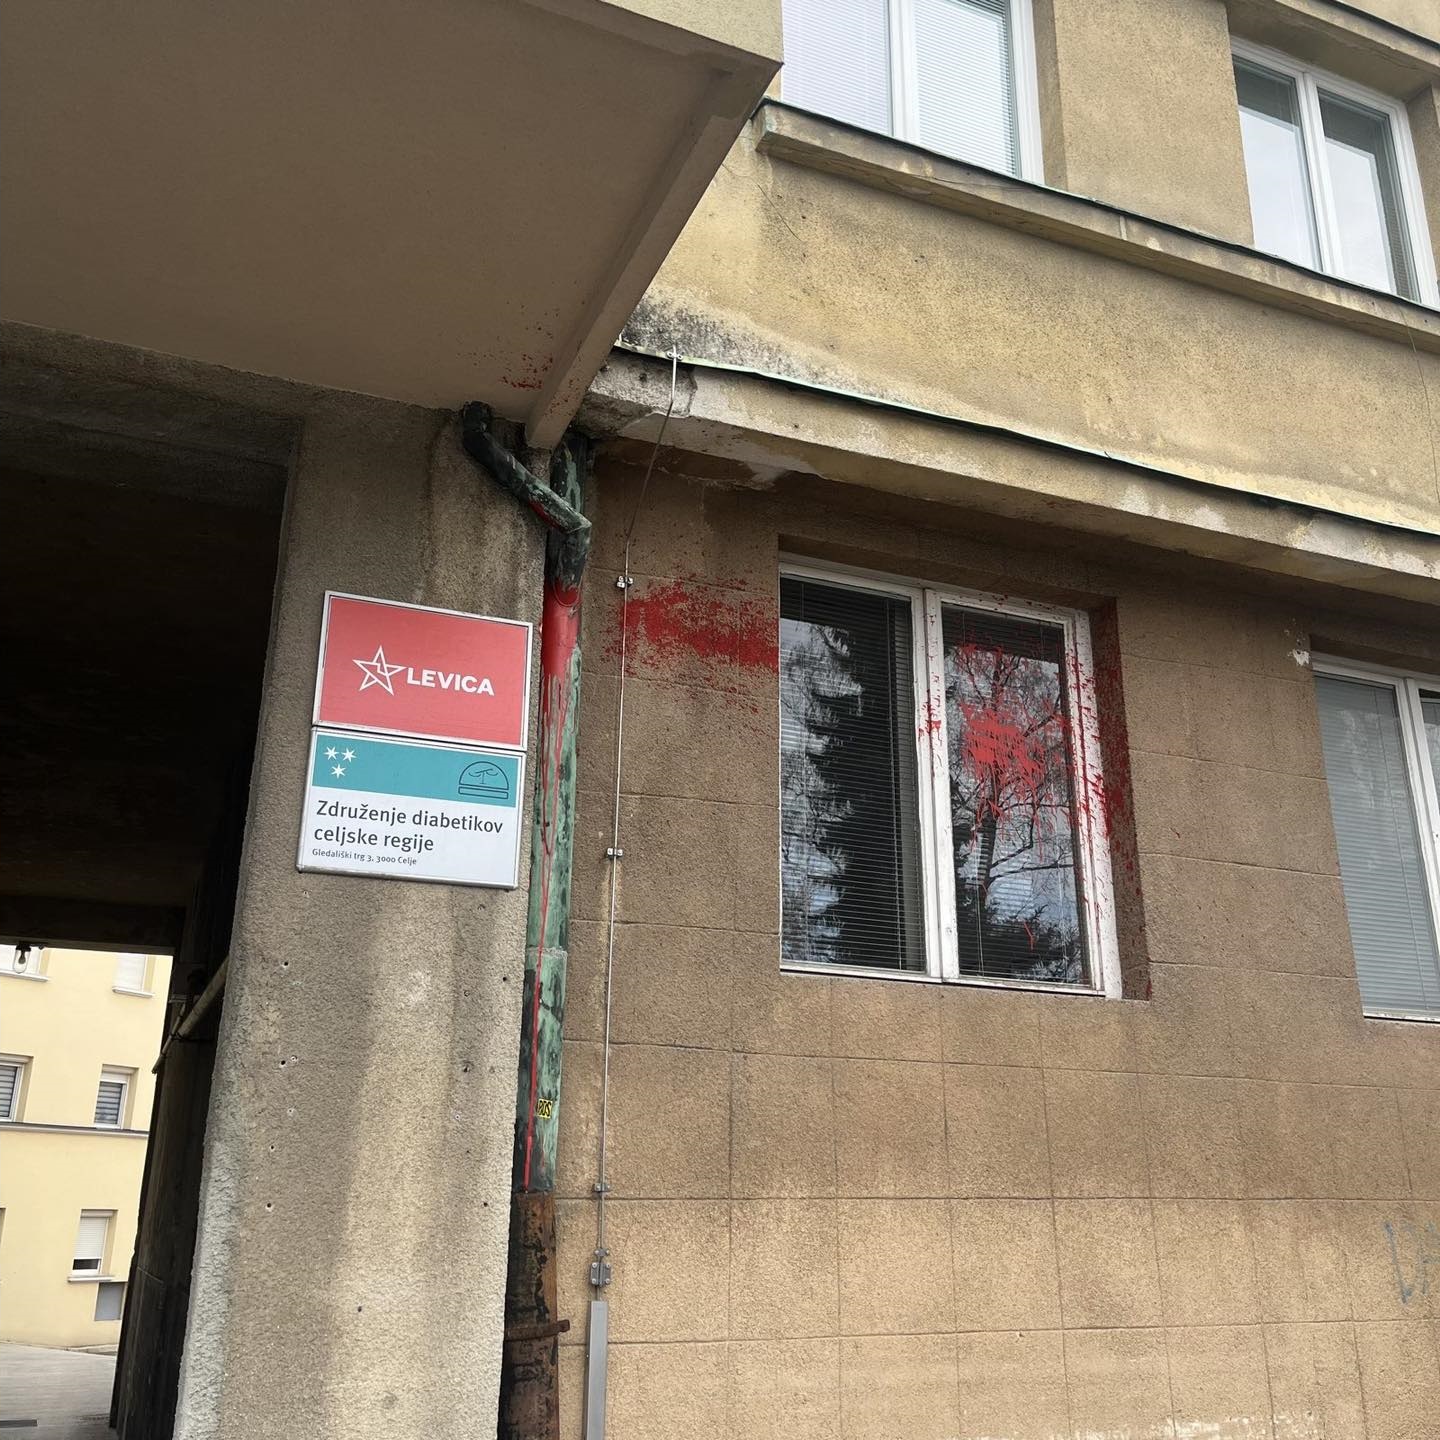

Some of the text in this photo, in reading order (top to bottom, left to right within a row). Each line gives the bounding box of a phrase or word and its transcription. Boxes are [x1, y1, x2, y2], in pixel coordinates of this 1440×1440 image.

[407, 667, 495, 696] LEVICA
[316, 800, 504, 834] Združenje diabetikov
[314, 826, 434, 854] celjske regije
[312, 848, 352, 859] Gledališki
[354, 853, 365, 862] trg
[376, 856, 396, 864] 3000
[397, 856, 417, 866] Celje
